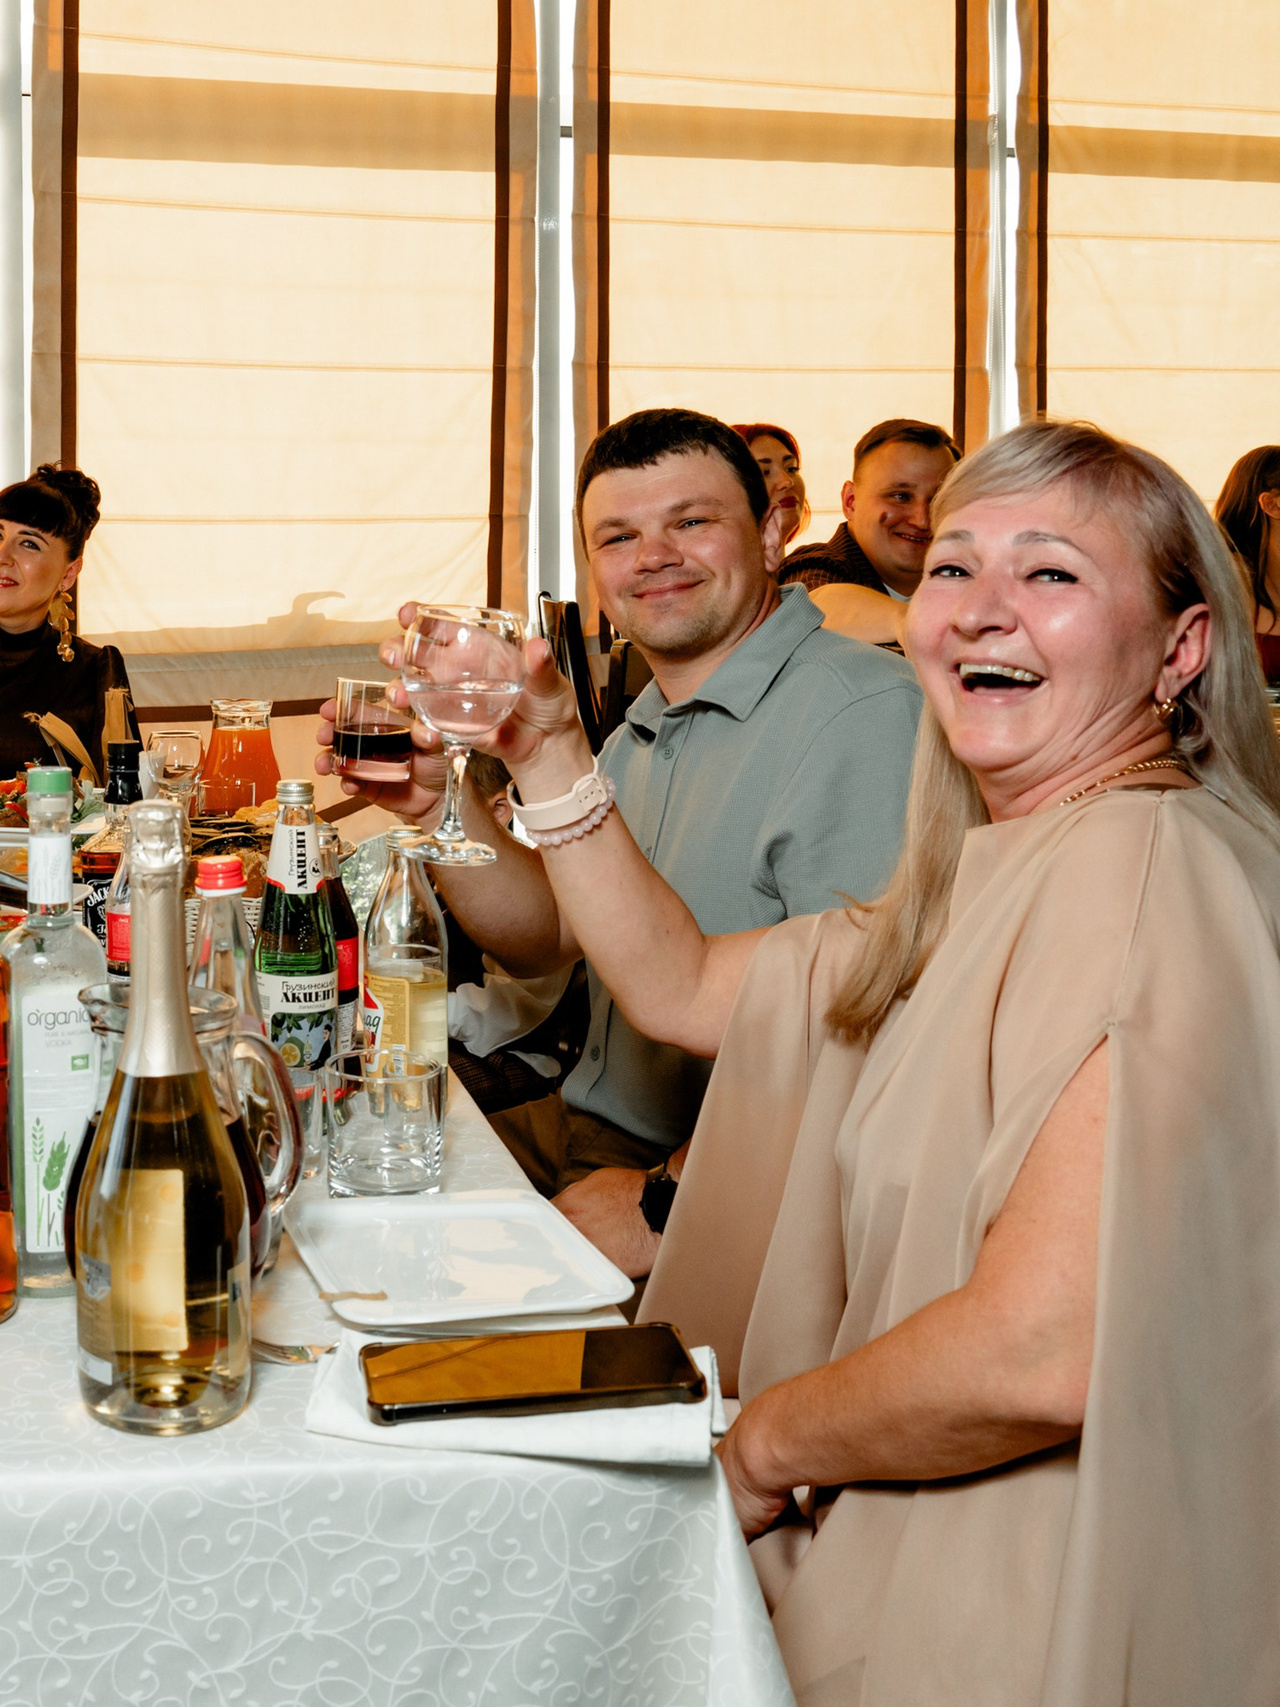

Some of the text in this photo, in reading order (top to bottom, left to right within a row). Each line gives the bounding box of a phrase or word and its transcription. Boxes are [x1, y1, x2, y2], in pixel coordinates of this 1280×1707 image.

[296, 829, 308, 889] АКЦЕНТ
[281, 978, 336, 992] Грузинский
[281, 987, 336, 1004] АКЦЕНТ
